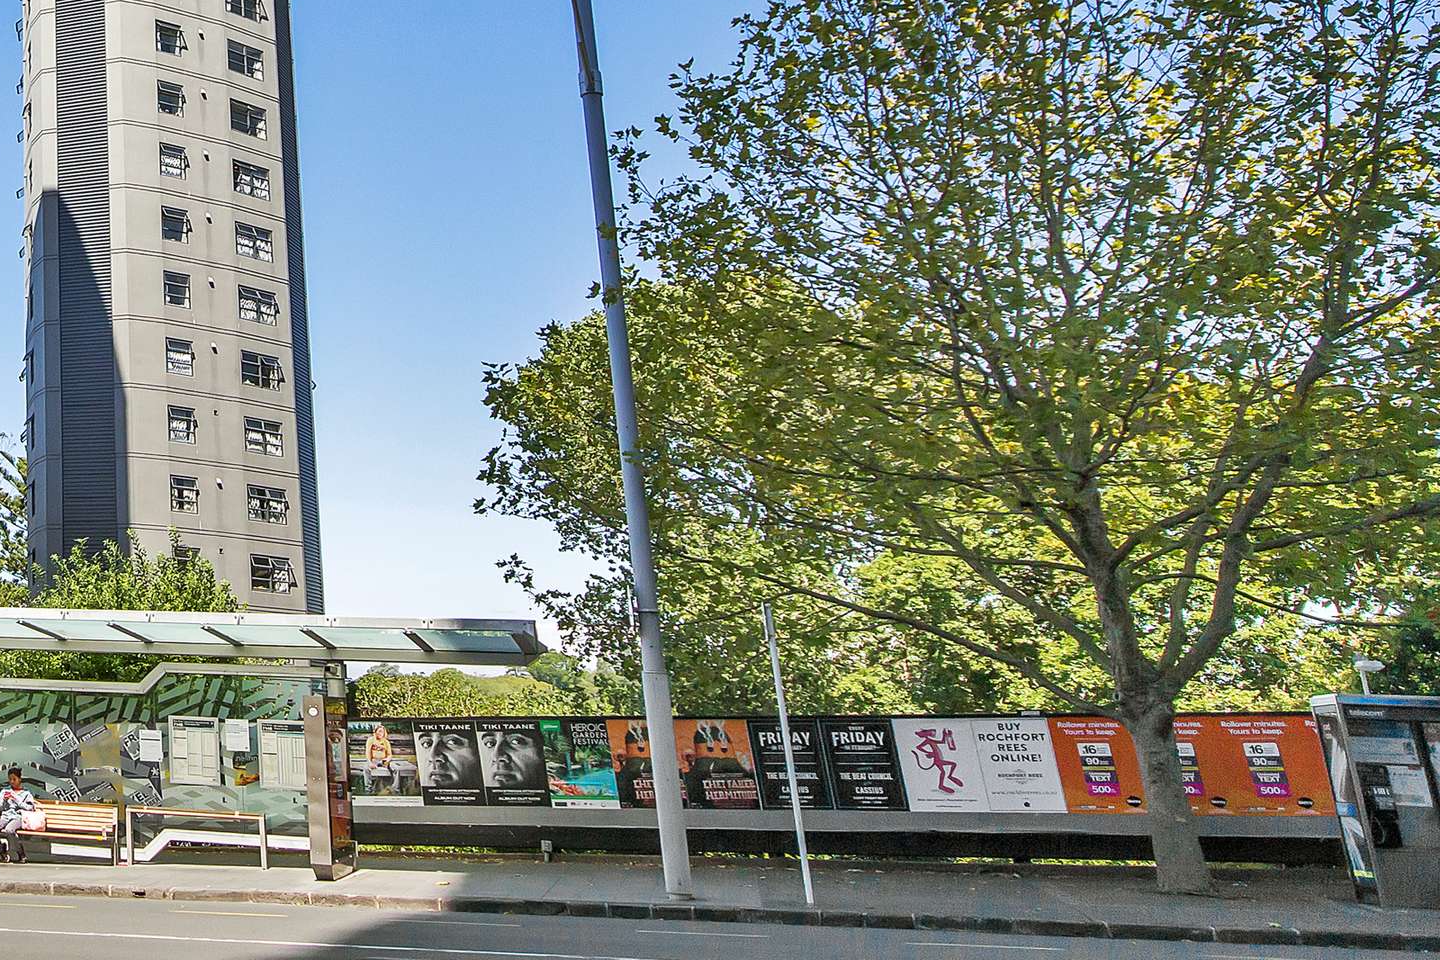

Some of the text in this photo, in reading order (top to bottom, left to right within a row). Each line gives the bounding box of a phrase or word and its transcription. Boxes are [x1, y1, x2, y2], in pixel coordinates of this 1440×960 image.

[1349, 709, 1383, 717] telecom
[570, 723, 606, 732] HEROIC
[997, 722, 1021, 731] BUY
[758, 731, 810, 747] FRIAY
[831, 731, 885, 747] FRIDAY
[978, 733, 1046, 741] ROCHFORT
[997, 743, 1027, 752] REES
[991, 753, 1042, 762] ONLINE!
[1085, 757, 1099, 765] 90
[1253, 758, 1267, 766] 90
[840, 772, 851, 780] THE
[868, 772, 893, 780] COUNCIL
[855, 786, 884, 794] CASSIUS
[1092, 785, 1111, 793] 500
[1260, 786, 1280, 795] 500
